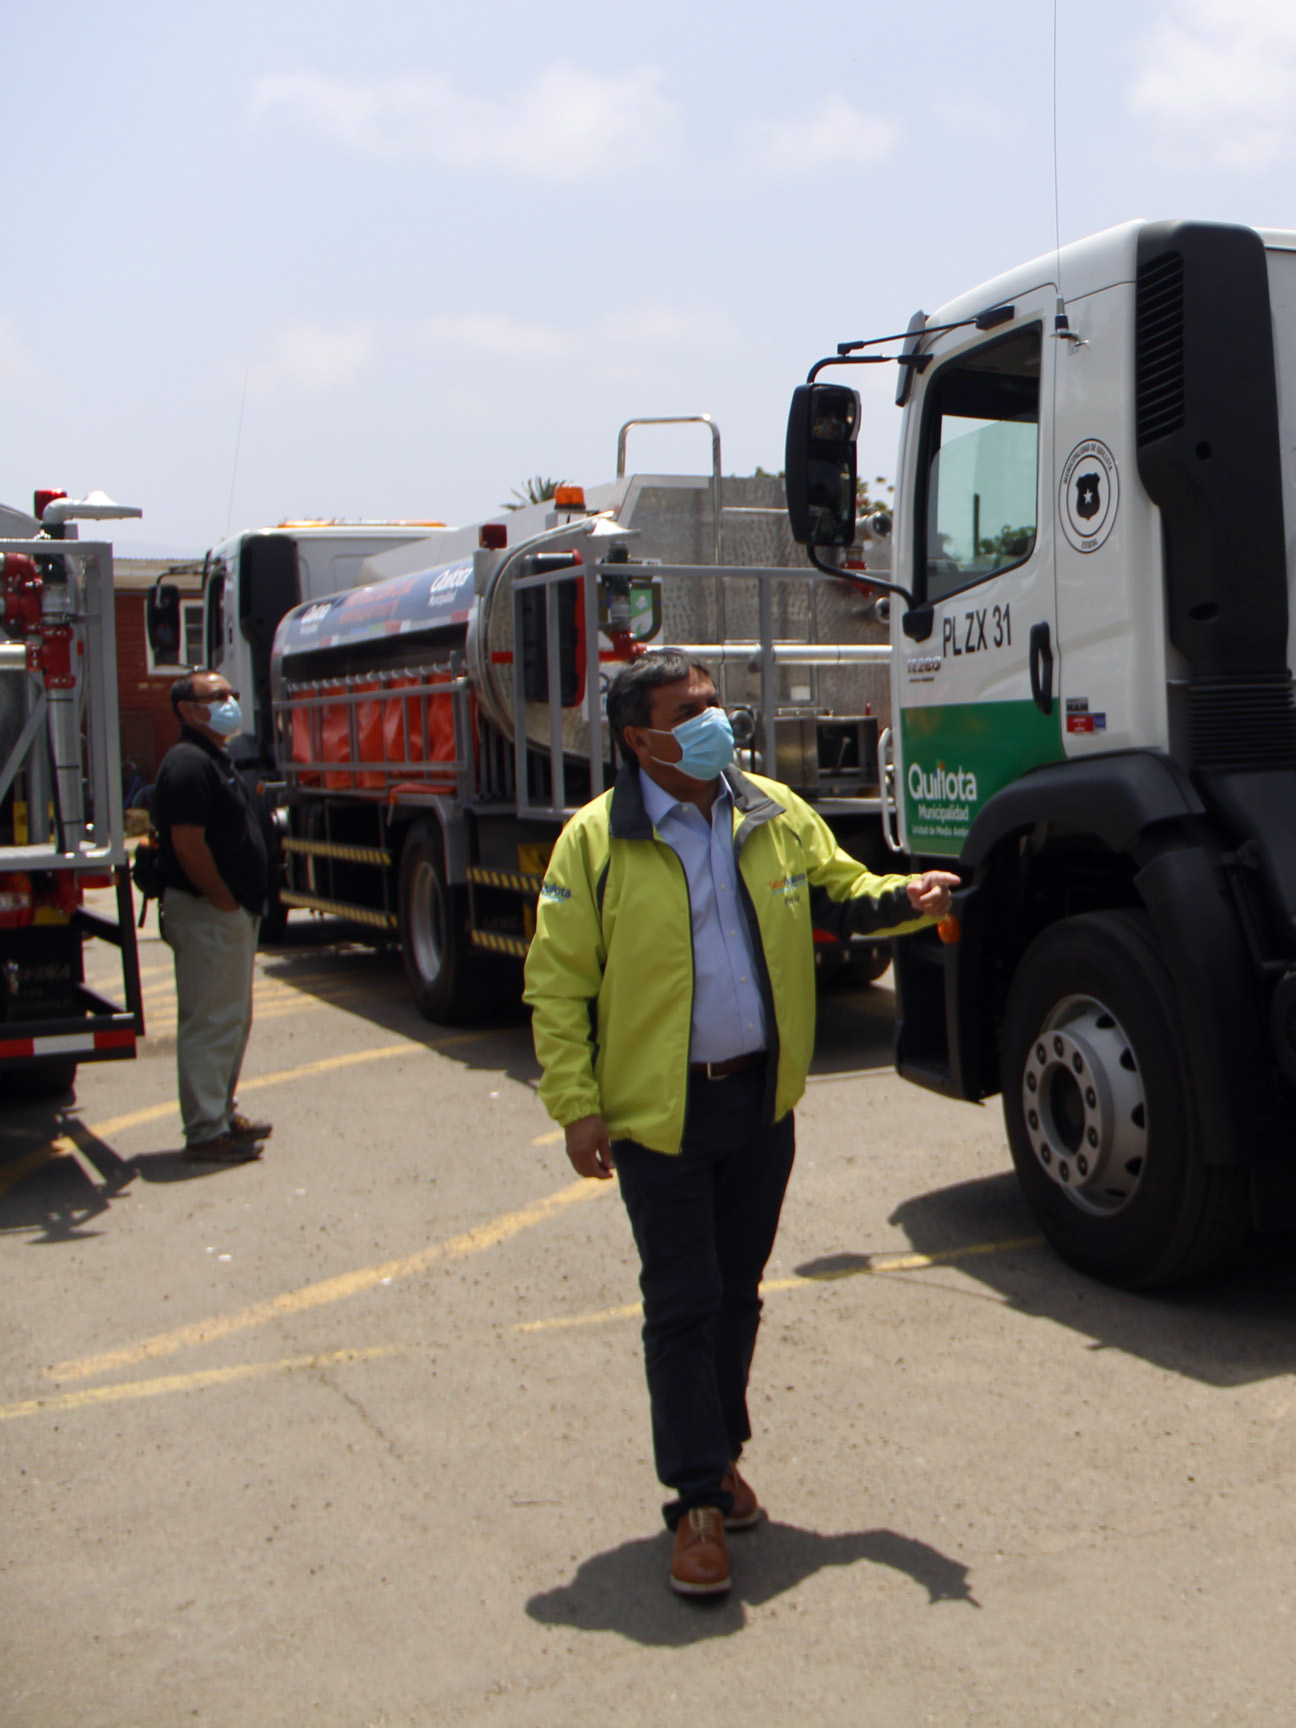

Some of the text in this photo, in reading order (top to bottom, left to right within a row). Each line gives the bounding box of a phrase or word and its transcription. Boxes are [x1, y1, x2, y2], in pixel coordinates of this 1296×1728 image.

[992, 603, 1011, 648] 31
[907, 760, 978, 802] Quillota
[918, 803, 969, 824] Municipalidad
